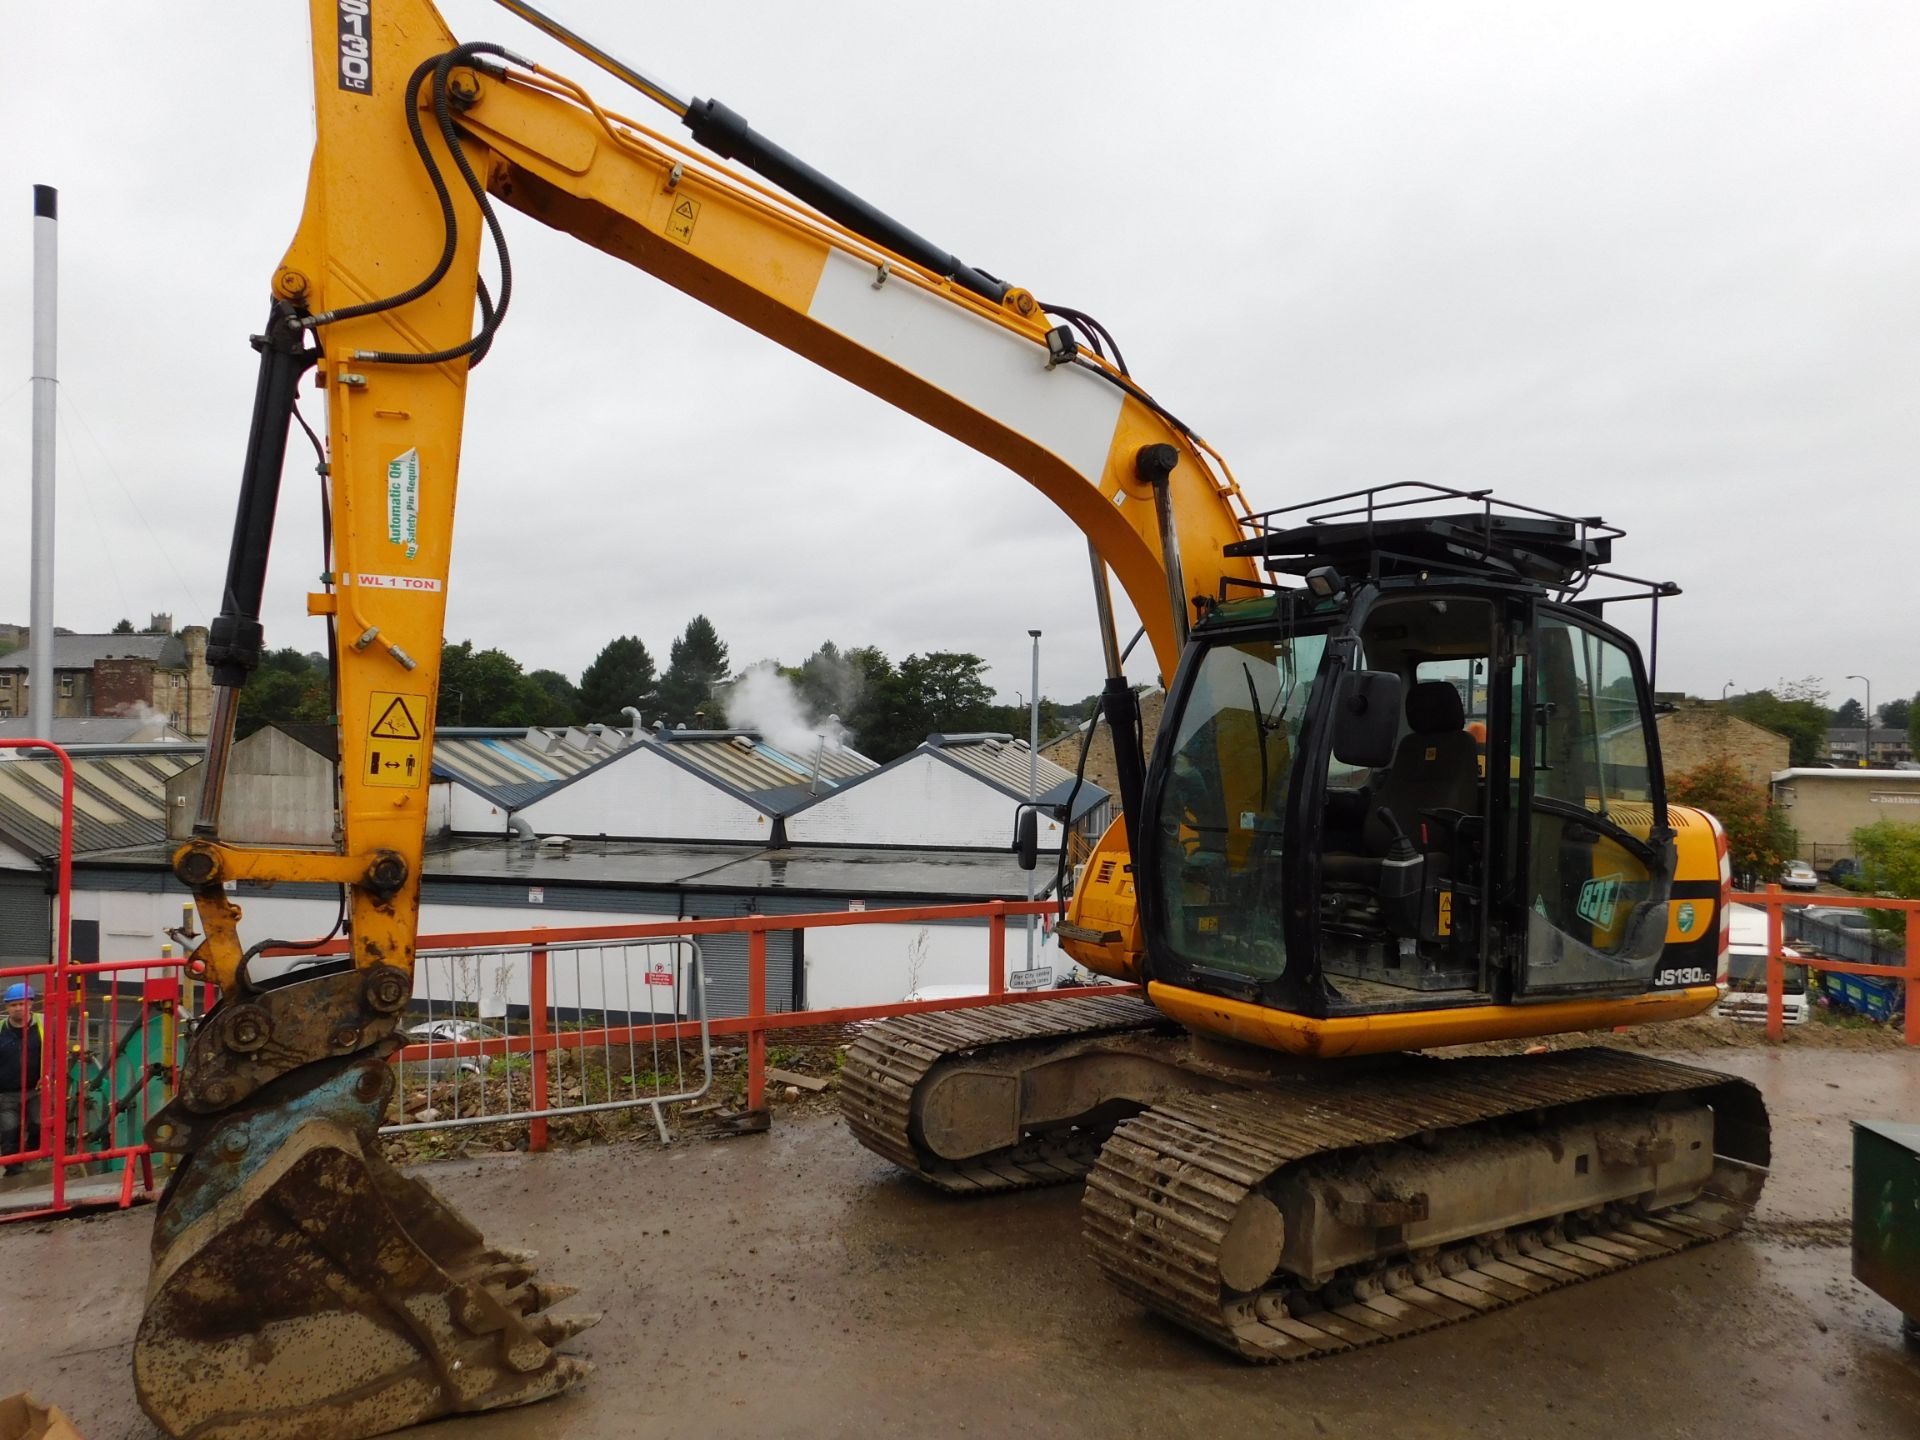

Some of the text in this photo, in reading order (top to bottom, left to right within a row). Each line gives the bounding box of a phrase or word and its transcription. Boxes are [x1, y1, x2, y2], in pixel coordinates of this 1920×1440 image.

[389, 462, 401, 544] Automatic QH
[406, 494, 415, 511] Pin
[406, 514, 416, 543] Safety
[360, 576, 434, 590] WL 1 TON
